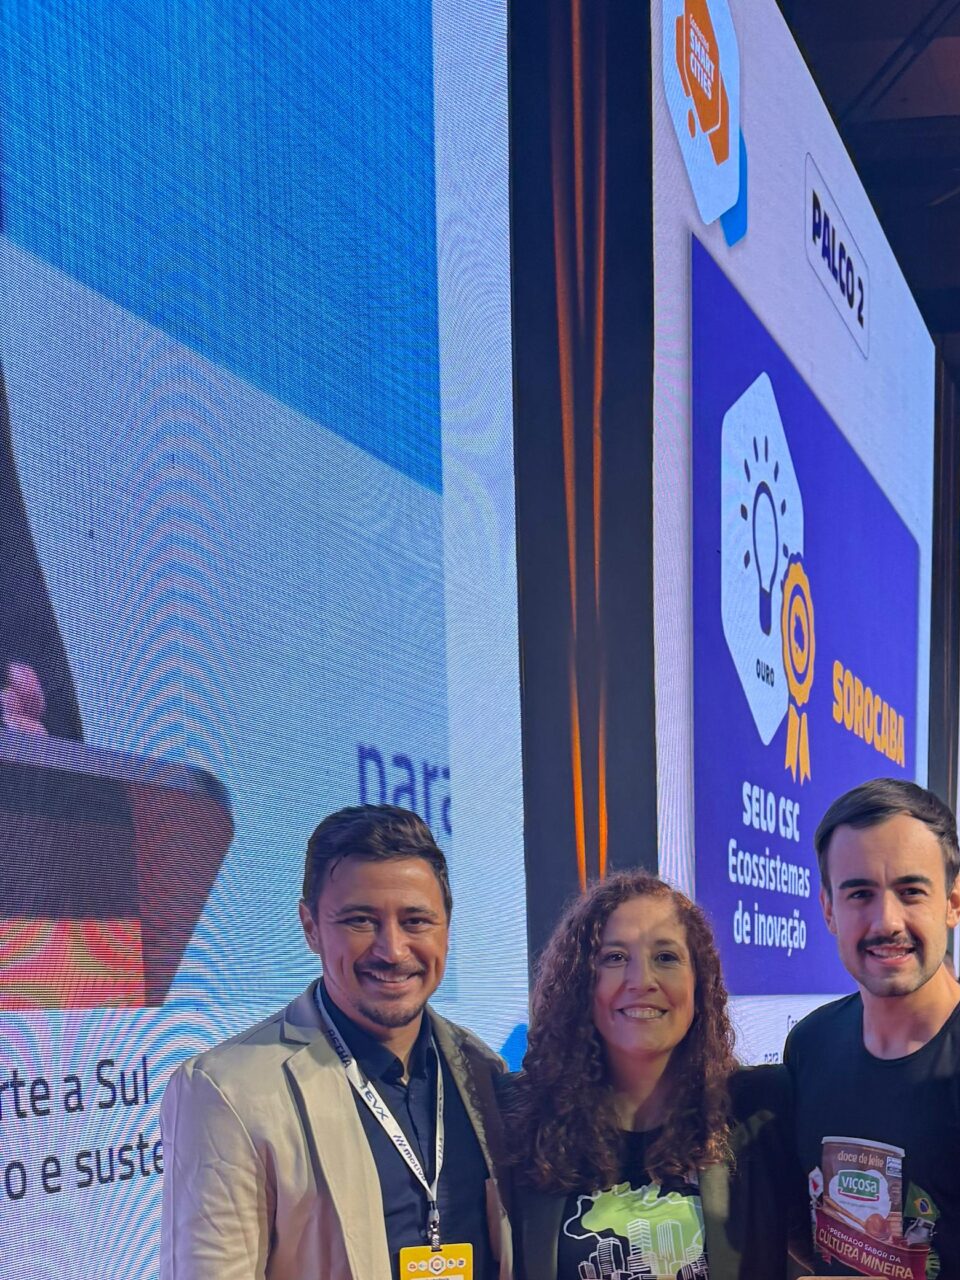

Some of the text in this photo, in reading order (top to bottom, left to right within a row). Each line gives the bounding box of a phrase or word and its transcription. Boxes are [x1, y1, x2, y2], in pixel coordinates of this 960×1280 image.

[812, 189, 865, 329] PALCO 2
[756, 658, 774, 687] OURO
[833, 660, 905, 768] SOROCABA
[742, 781, 800, 842] SELO CSC
[728, 838, 810, 898] Ecossistemas
[733, 900, 806, 957] de inovação
[64, 1074, 84, 1113] a
[96, 1054, 149, 1109] Sul
[42, 1155, 61, 1194] e
[838, 1151, 858, 1162] doce
[858, 1153, 867, 1164] de
[868, 1154, 884, 1167] leite
[819, 1229, 914, 1280] CULTURA MINEIRA
[830, 1227, 864, 1248] PREMIADO
[864, 1244, 888, 1258] SABOR
[889, 1254, 901, 1264] DA
